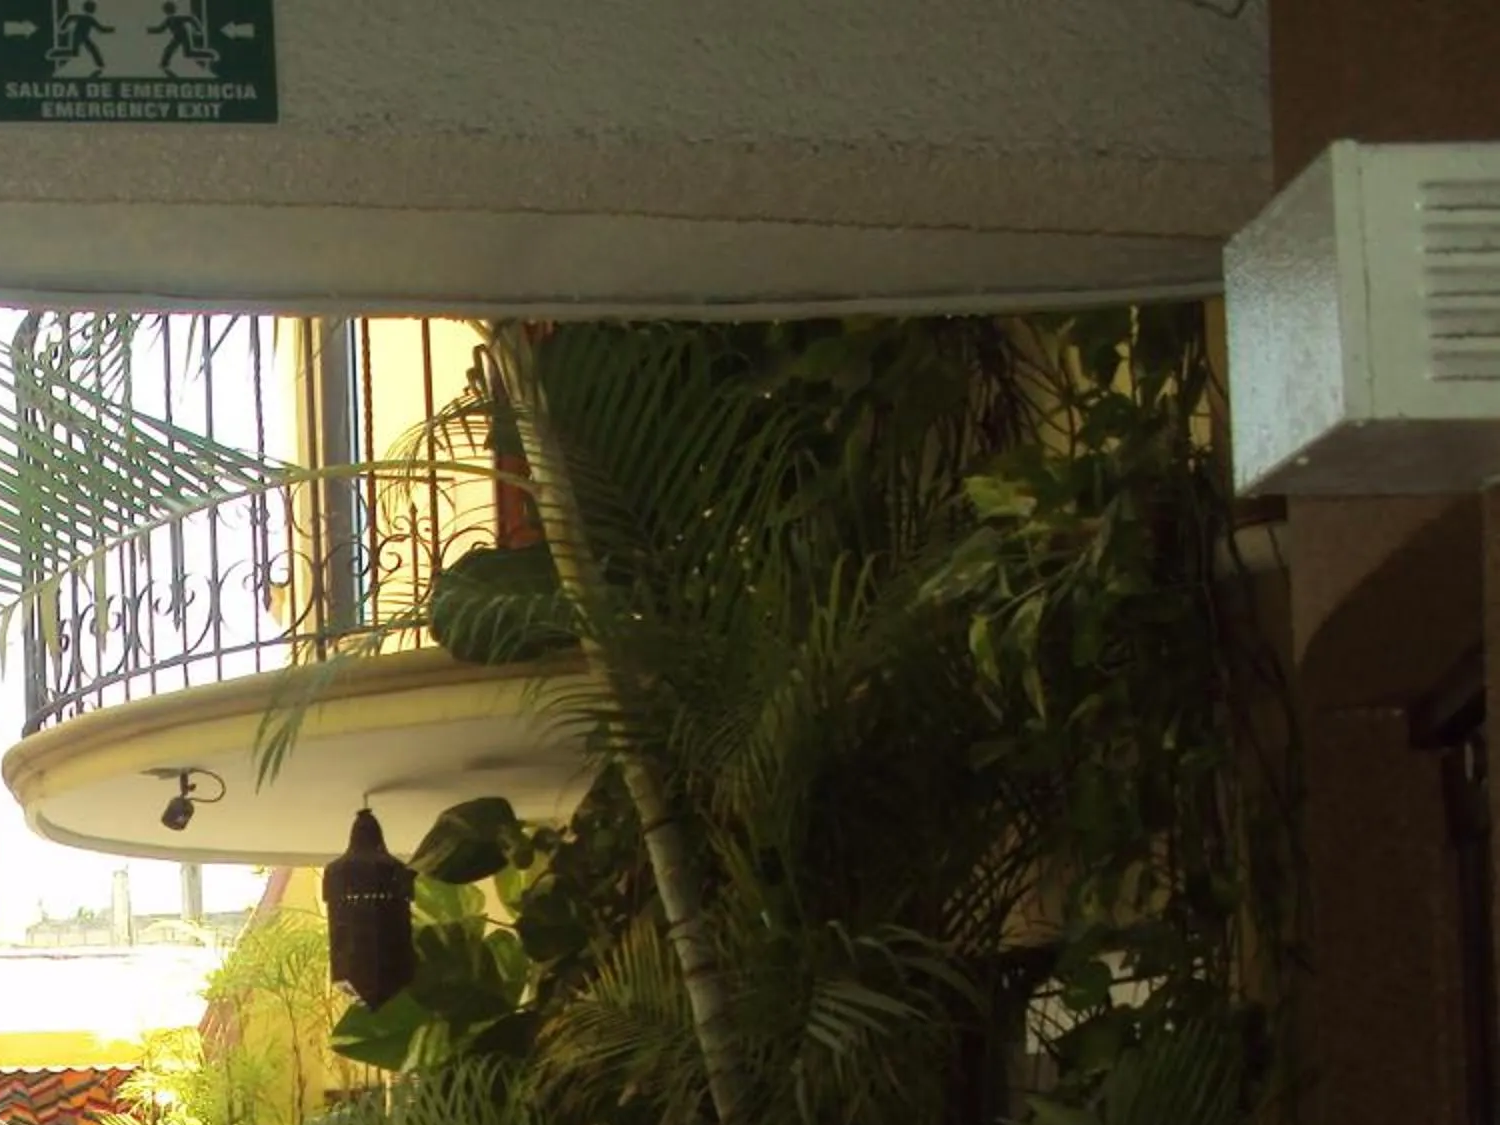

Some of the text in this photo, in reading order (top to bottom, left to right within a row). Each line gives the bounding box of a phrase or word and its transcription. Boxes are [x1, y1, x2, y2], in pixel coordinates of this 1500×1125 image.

[5, 82, 257, 99] SALIDA DE EMERGENCIA
[41, 102, 223, 119] EMERGENCY EXIT
